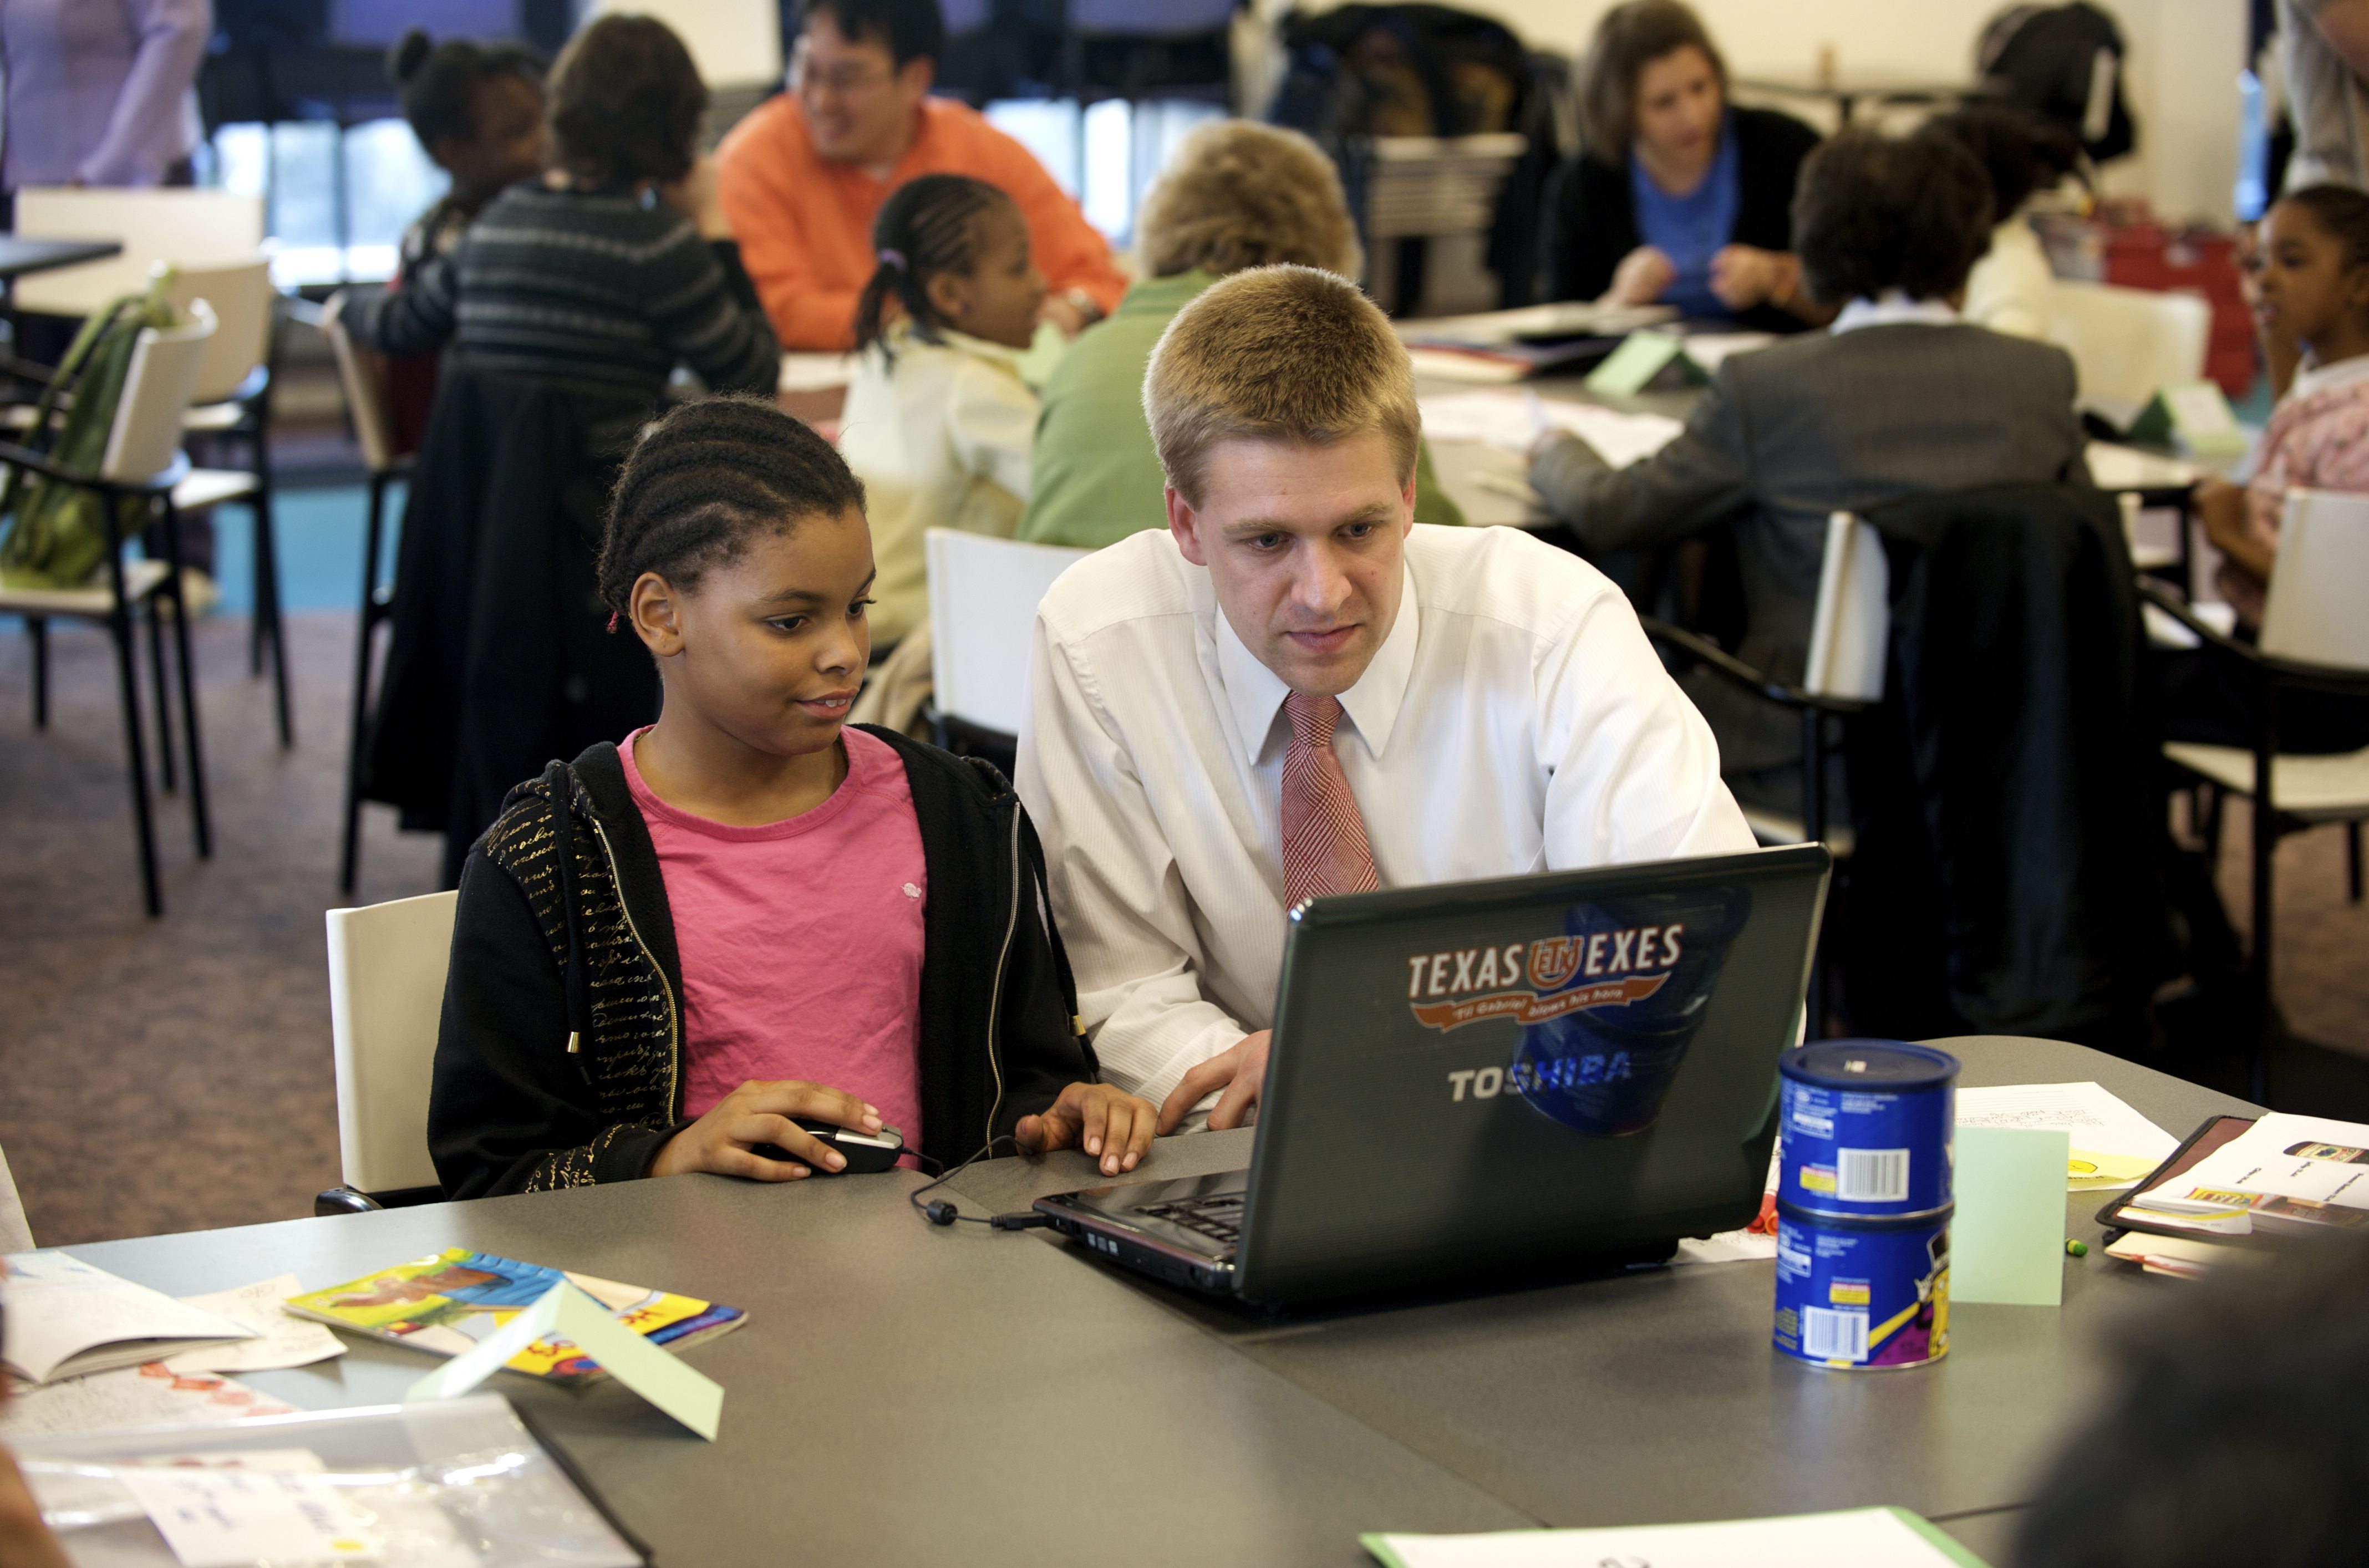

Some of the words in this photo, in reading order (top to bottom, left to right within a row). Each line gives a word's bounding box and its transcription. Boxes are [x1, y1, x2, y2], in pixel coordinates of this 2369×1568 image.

[1409, 943, 1523, 998] TEXAS
[1584, 924, 1685, 976] EXES
[1476, 997, 1528, 1014] Gabriel
[1527, 999, 1567, 1017] blows
[1568, 991, 1590, 1006] his
[1591, 988, 1624, 1000] horn
[1447, 1050, 1633, 1102] TOSHIBA
